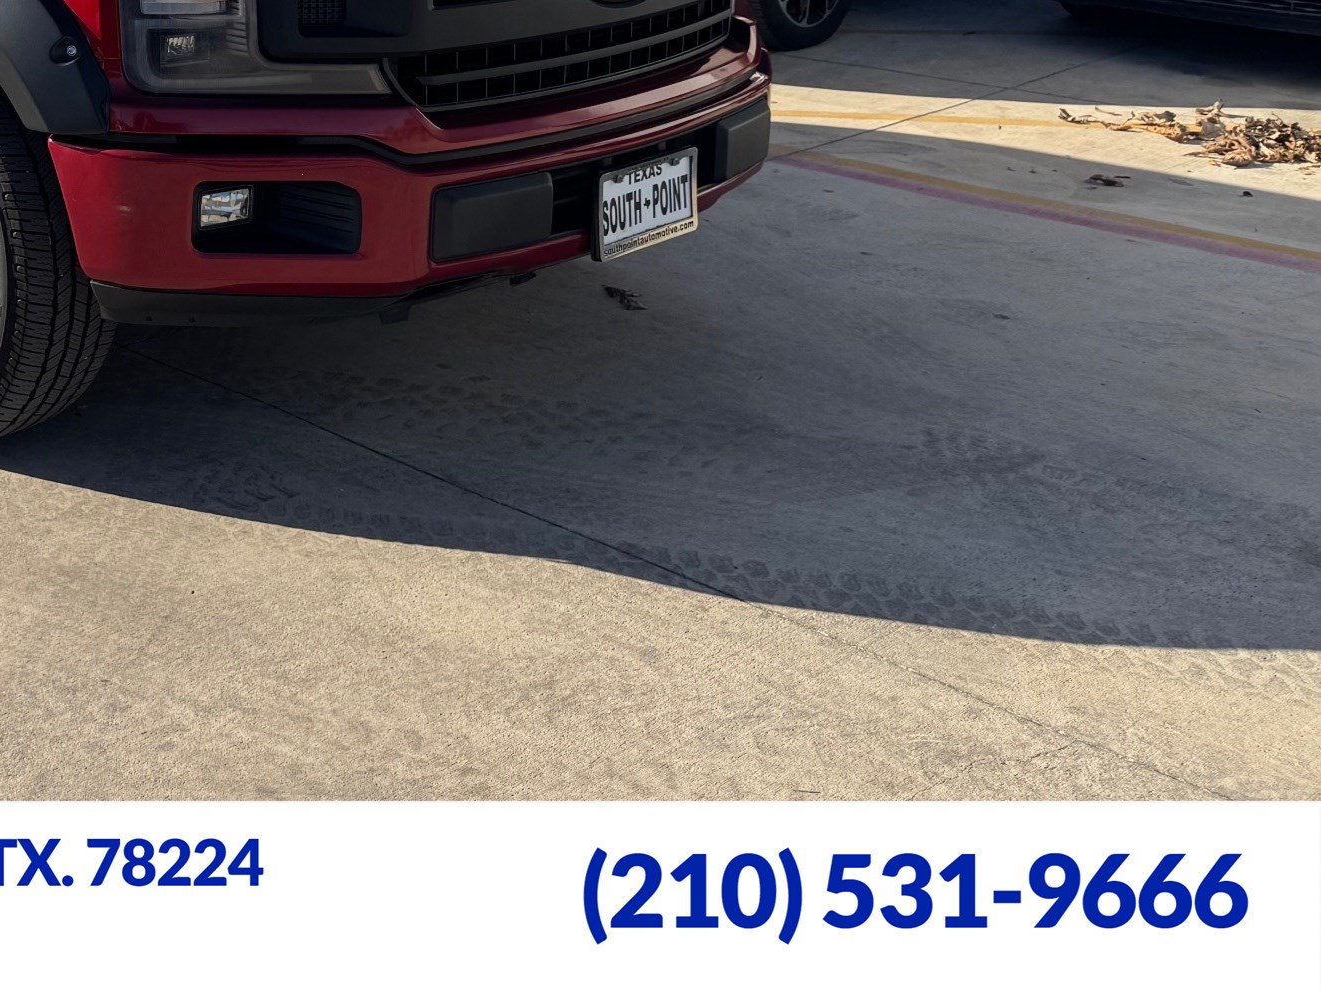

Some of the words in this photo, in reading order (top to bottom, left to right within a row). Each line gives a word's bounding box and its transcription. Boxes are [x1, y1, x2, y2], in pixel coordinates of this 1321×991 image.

[627, 164, 663, 185] TEXAS
[602, 188, 642, 237] SOUTH
[652, 173, 688, 219] POINT
[603, 220, 695, 257] southpointautomotive.com
